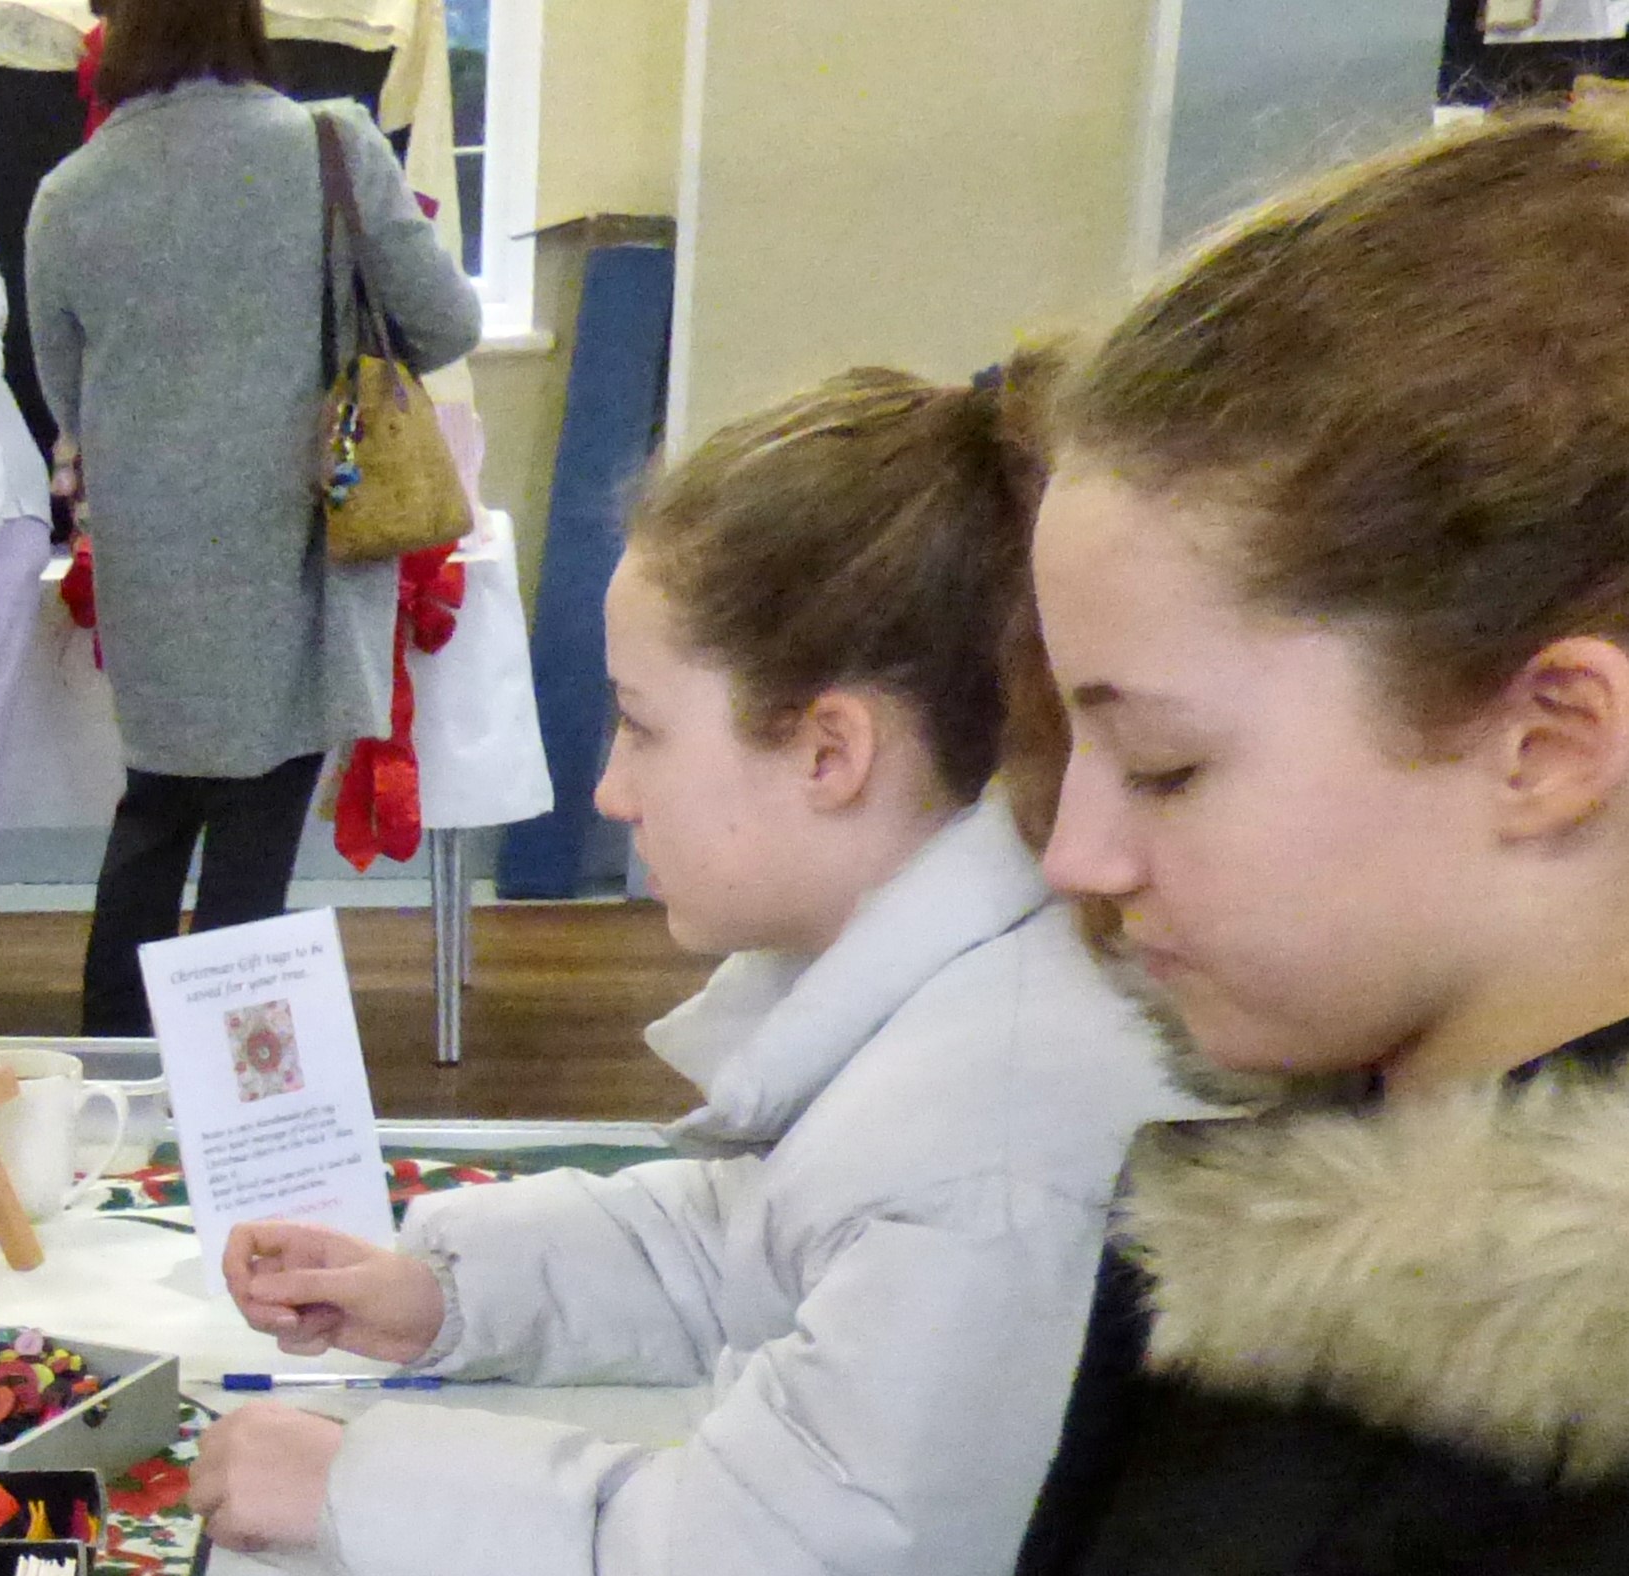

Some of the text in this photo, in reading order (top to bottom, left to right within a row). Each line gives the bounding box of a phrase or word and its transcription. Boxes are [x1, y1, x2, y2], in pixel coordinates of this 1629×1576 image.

[171, 963, 235, 984] Christmas
[238, 953, 261, 972] Gift
[296, 947, 307, 957] to
[226, 980, 243, 995] for
[250, 975, 277, 994] your
